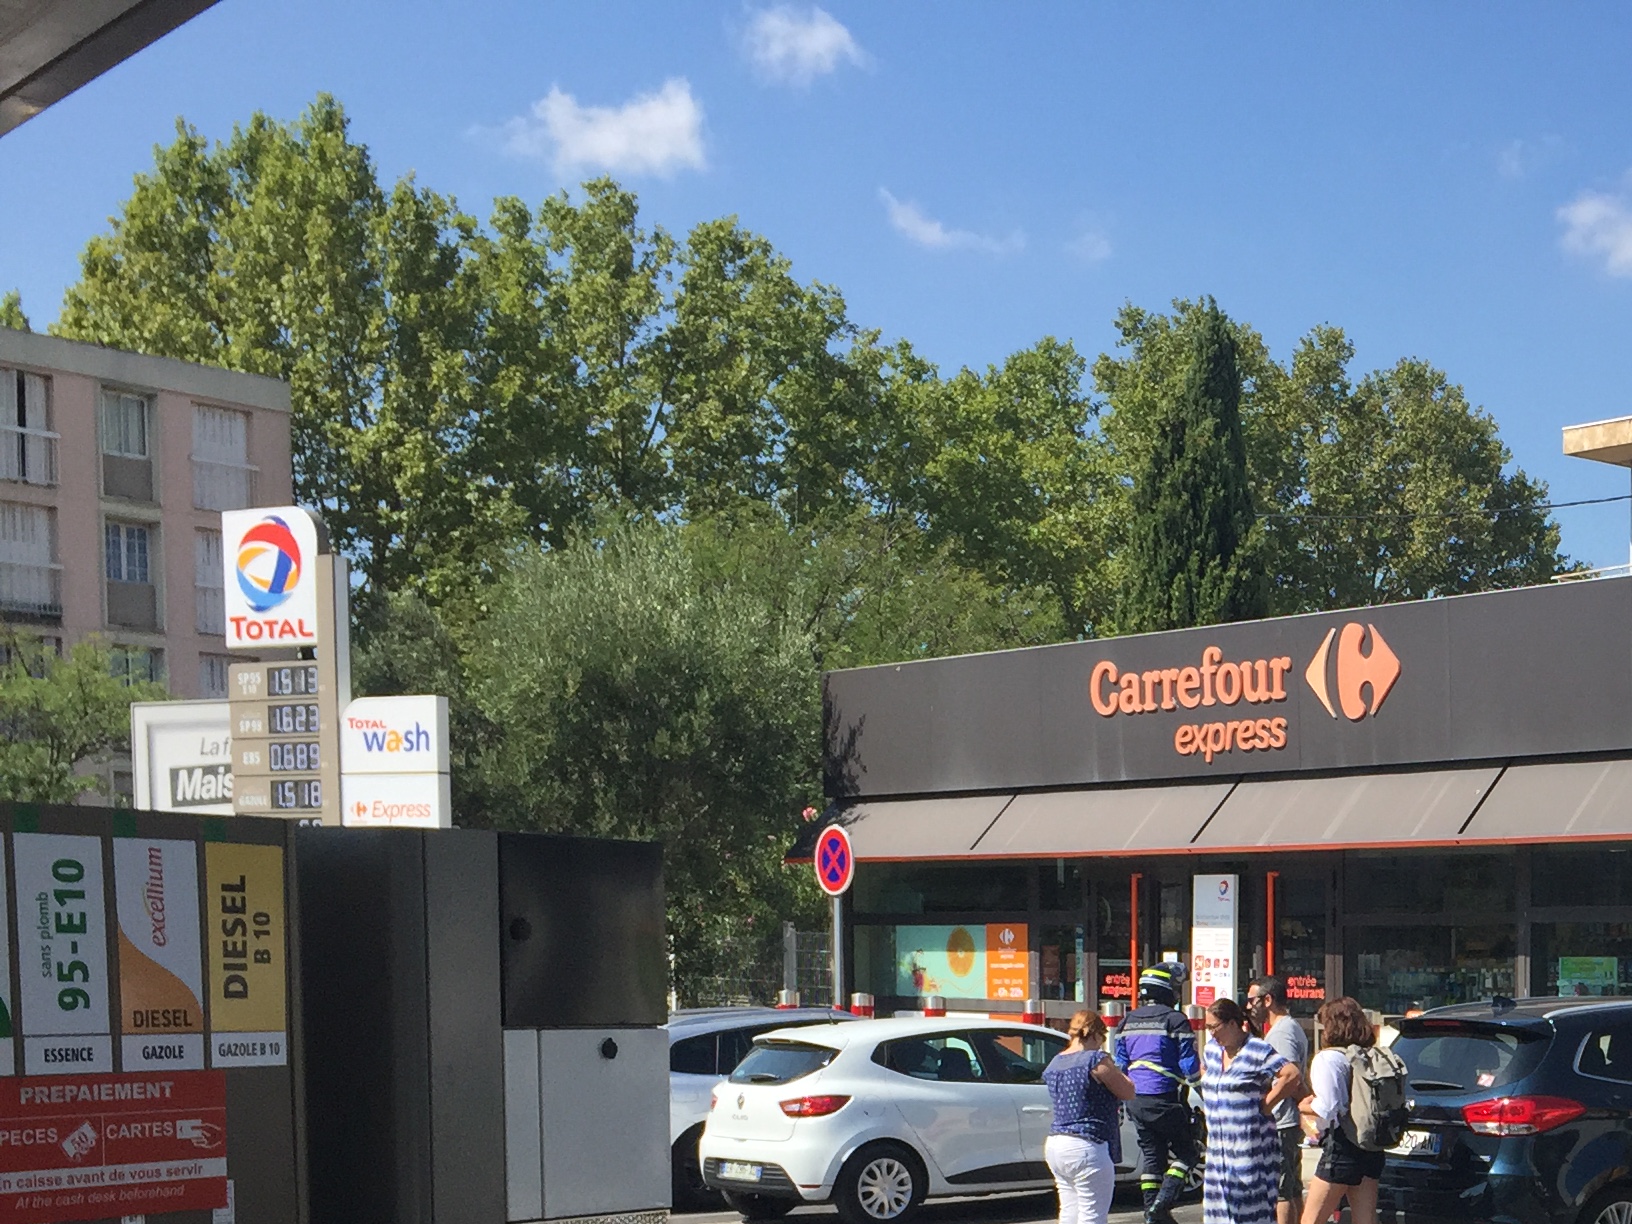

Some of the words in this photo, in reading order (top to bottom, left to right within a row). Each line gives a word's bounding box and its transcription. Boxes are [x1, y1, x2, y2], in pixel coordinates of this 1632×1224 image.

[229, 616, 314, 640] TOTAL
[1089, 645, 1292, 717] Carrefour
[347, 717, 387, 729] TOTAL
[200, 736, 219, 755] La
[363, 721, 430, 752] wash
[1174, 716, 1288, 764] express
[176, 766, 234, 801] Mais
[372, 800, 431, 824] Express
[147, 846, 168, 948] excellium
[35, 891, 54, 940] plomb
[253, 911, 271, 939] 10
[52, 858, 91, 1012] 95-E10
[221, 875, 248, 1001] DIESEL
[41, 945, 52, 978] sans
[254, 948, 272, 964] B
[133, 1009, 193, 1029] DIESEL
[44, 1047, 94, 1062] ESSENCE
[142, 1045, 184, 1060] GAZOLE
[218, 1044, 258, 1057] GAZOLE
[260, 1043, 267, 1056] B
[268, 1042, 280, 1056] 10
[20, 1081, 175, 1105] PREPAIEMENT
[106, 1121, 173, 1139] CARTES
[16, 1173, 62, 1188] caisse
[67, 1170, 105, 1185] avant
[109, 1168, 125, 1181] de
[130, 1168, 161, 1179] vous
[166, 1163, 203, 1177] servir
[32, 1195, 52, 1208] the
[56, 1192, 84, 1207] cash
